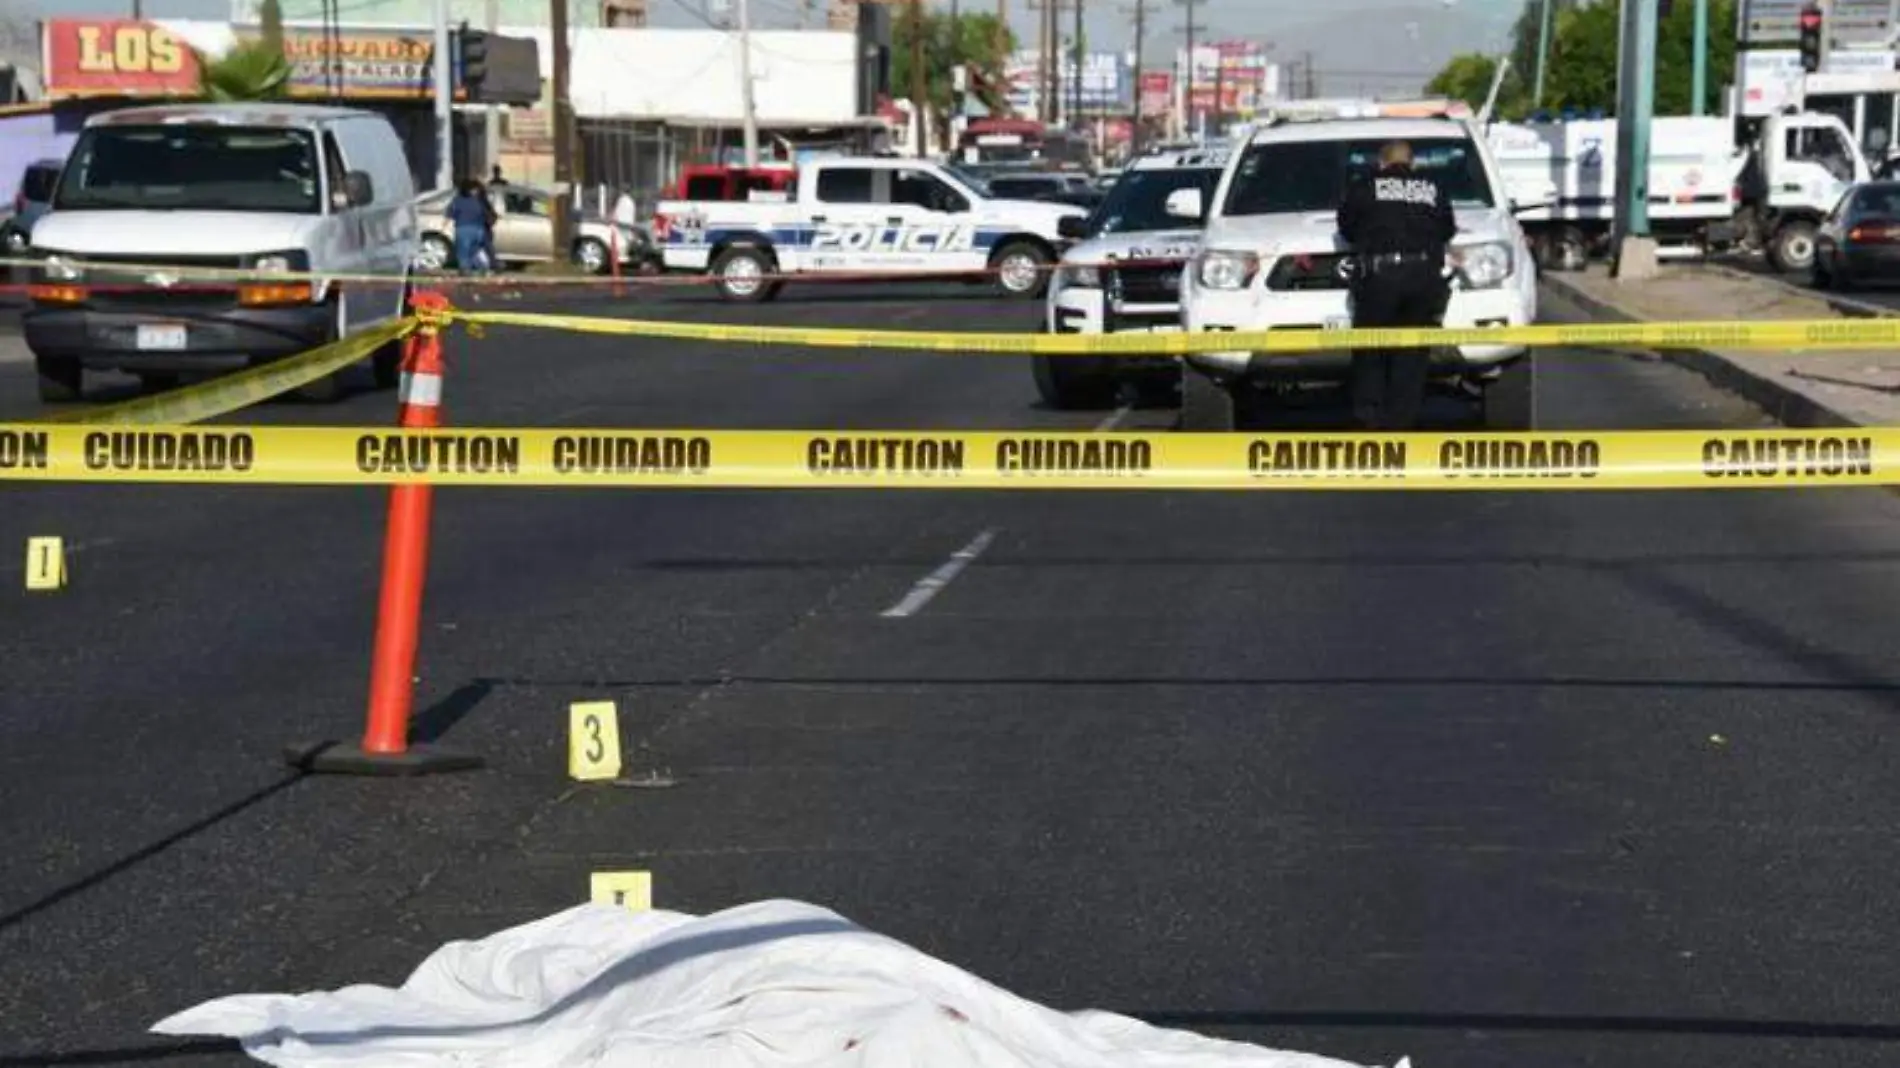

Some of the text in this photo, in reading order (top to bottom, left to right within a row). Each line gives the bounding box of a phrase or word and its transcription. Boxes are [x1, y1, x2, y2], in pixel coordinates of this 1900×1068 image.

[78, 26, 182, 73] LOS
[811, 225, 974, 253] POLICIA
[84, 432, 254, 471] CUIDADO
[356, 434, 518, 473] CAUTION
[553, 436, 711, 474] CUIDADO
[808, 438, 965, 477] CAUTION
[996, 439, 1151, 477] CUIDADO
[1248, 440, 1406, 478] CAUTION
[1440, 439, 1600, 478] CUIDADO
[1702, 437, 1872, 477] CAUTION
[584, 714, 605, 764] 3
